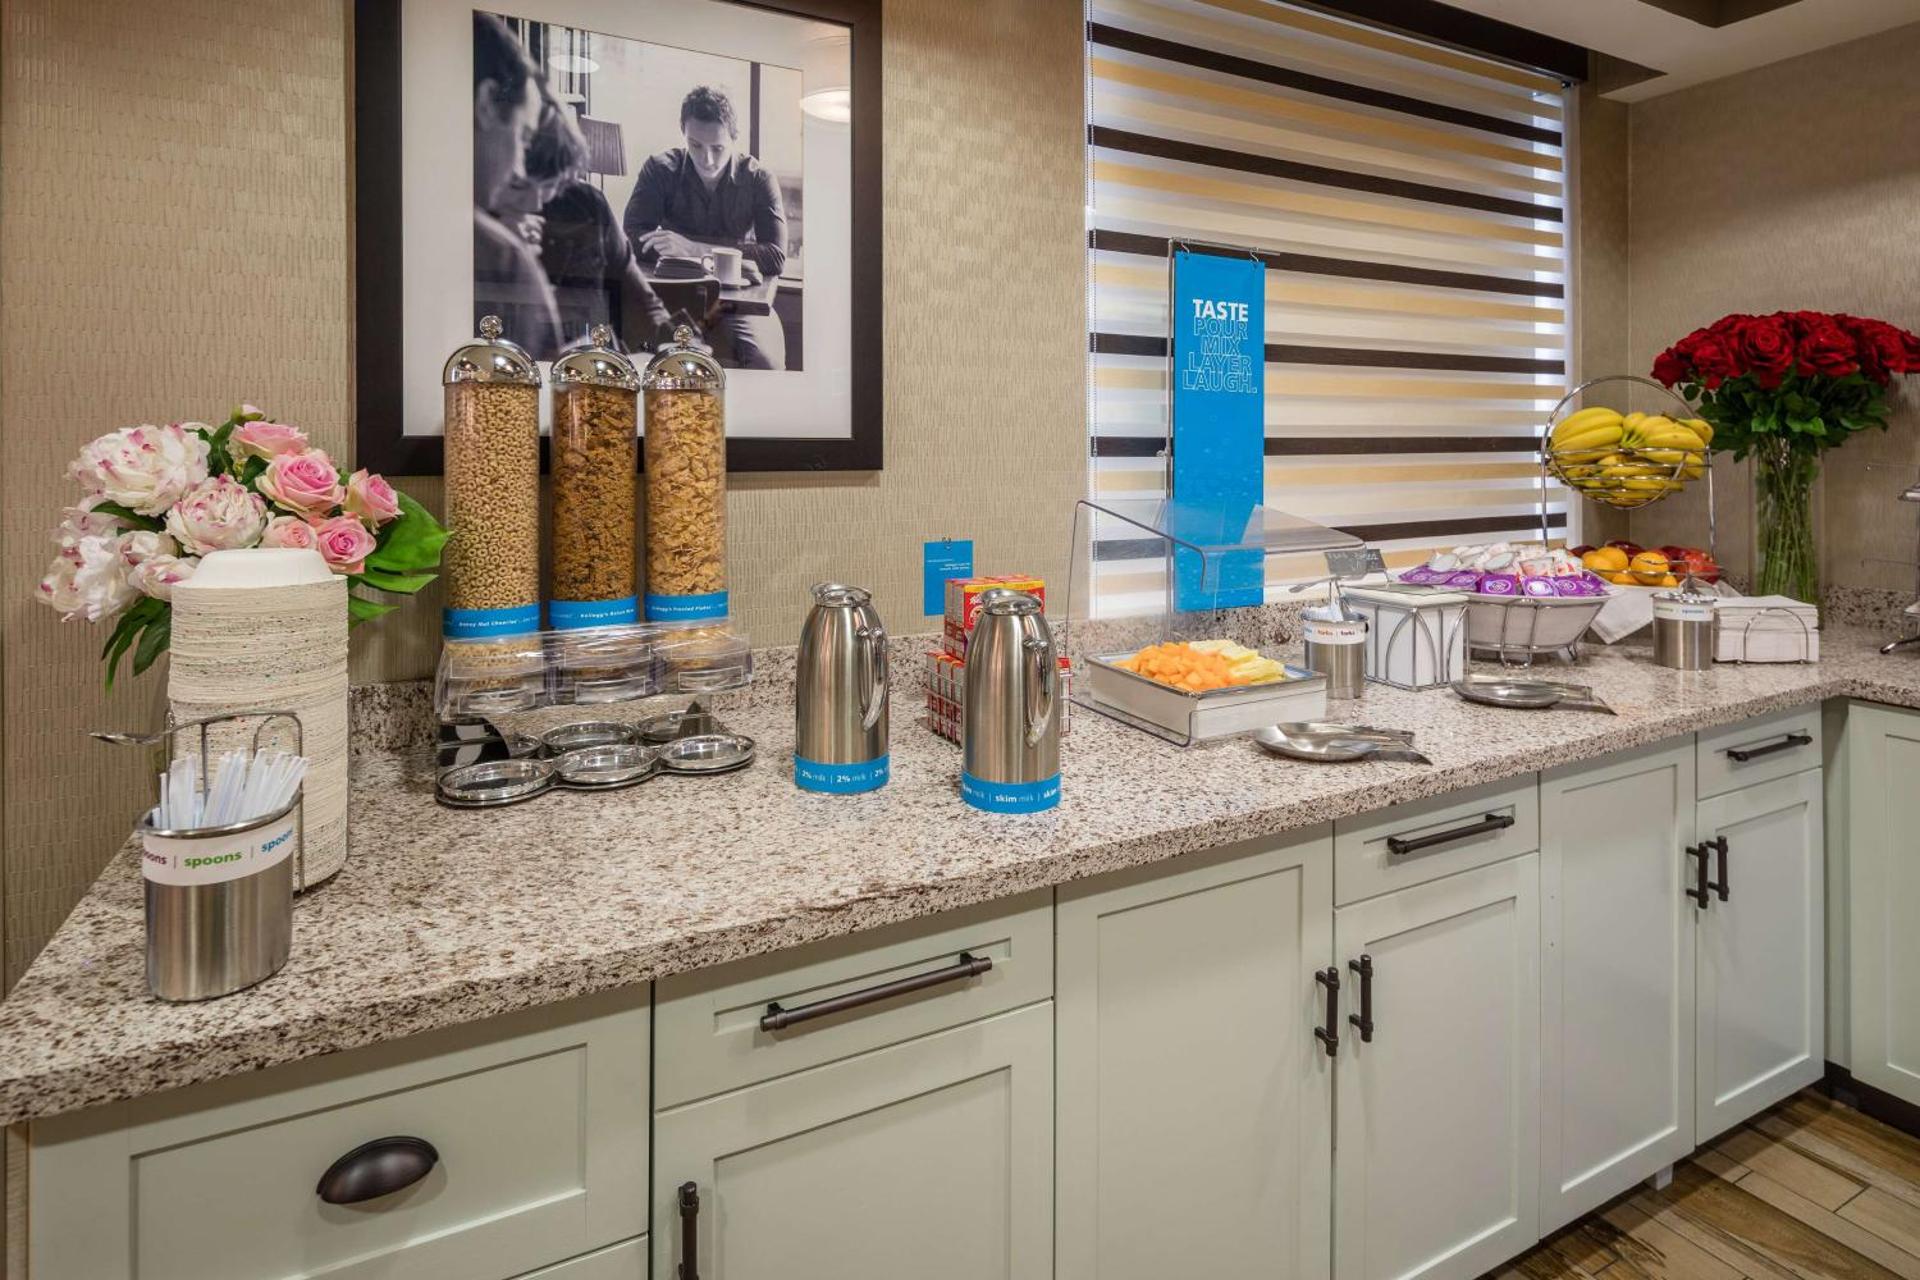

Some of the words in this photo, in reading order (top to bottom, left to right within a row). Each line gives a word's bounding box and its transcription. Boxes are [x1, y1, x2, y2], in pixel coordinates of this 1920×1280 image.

[1193, 299, 1248, 322] TASTE
[1193, 317, 1248, 340] POUR
[1201, 335, 1240, 356] MIX
[1188, 352, 1252, 376] LAYER
[1182, 369, 1258, 394] LAUGH.
[836, 774, 851, 783] 2%
[995, 793, 1017, 804] skim
[183, 850, 243, 869] spoons
[261, 826, 294, 853] spoon
